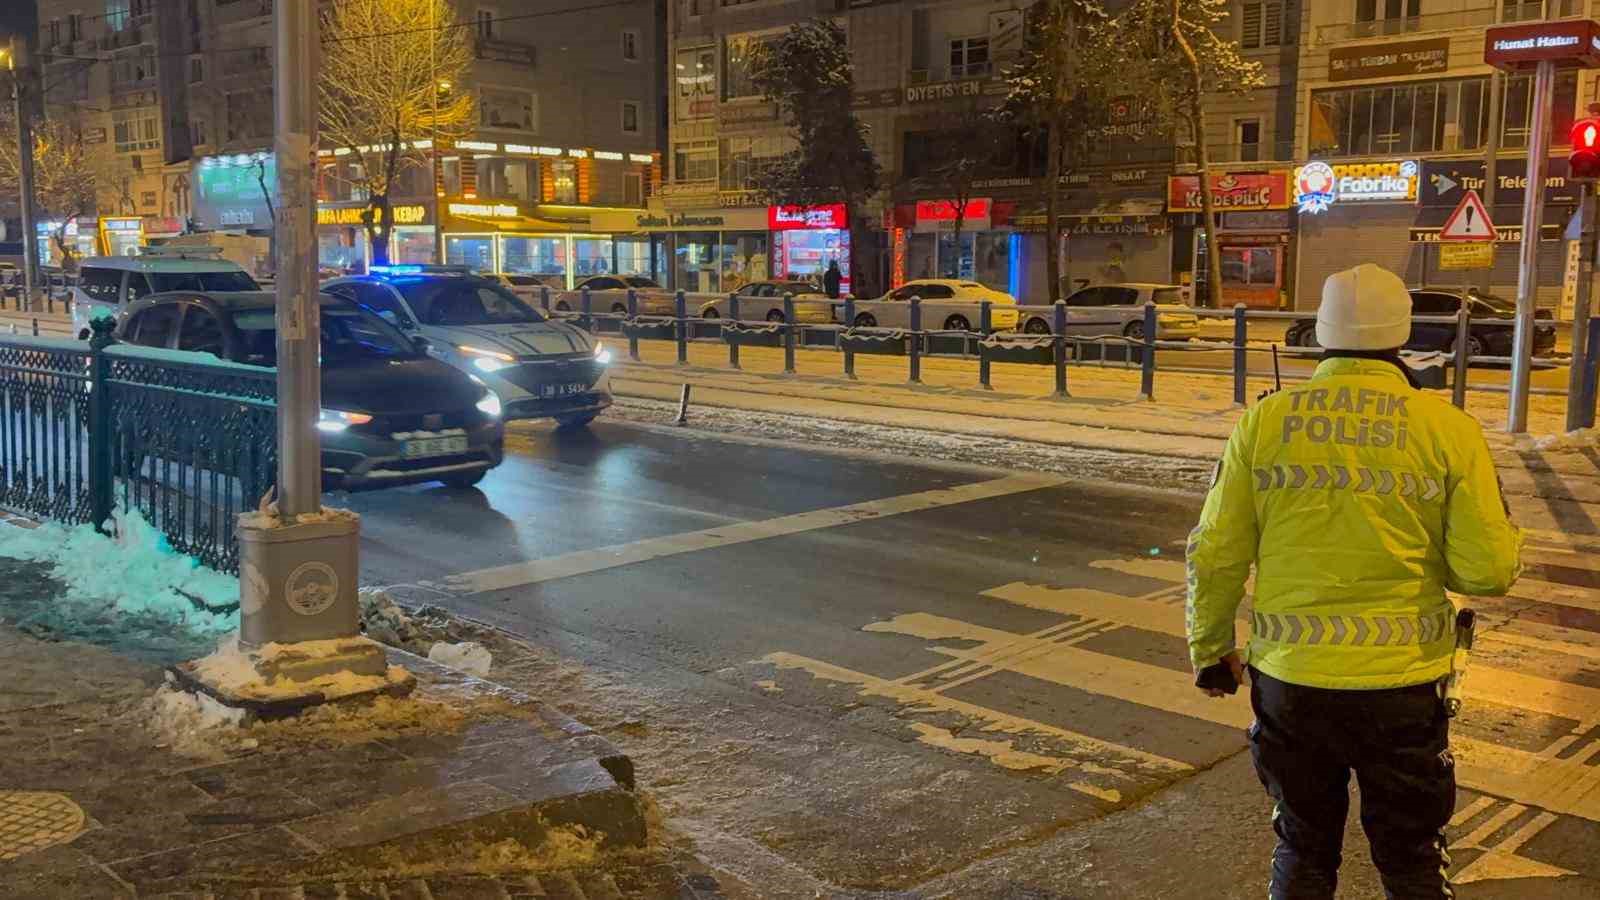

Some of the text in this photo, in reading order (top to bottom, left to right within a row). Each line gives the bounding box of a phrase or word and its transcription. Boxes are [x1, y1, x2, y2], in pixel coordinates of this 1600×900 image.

[1494, 36, 1579, 50] Hunat Hatun
[1340, 175, 1409, 193] Fabrika
[1461, 174, 1565, 190] Tür Telem
[1233, 187, 1271, 208] PİLİÇ
[392, 205, 426, 224] KEBAP
[1416, 233, 1441, 241] TEK
[1288, 387, 1409, 417] TRAFİK
[1281, 415, 1408, 450] POLİSİ
